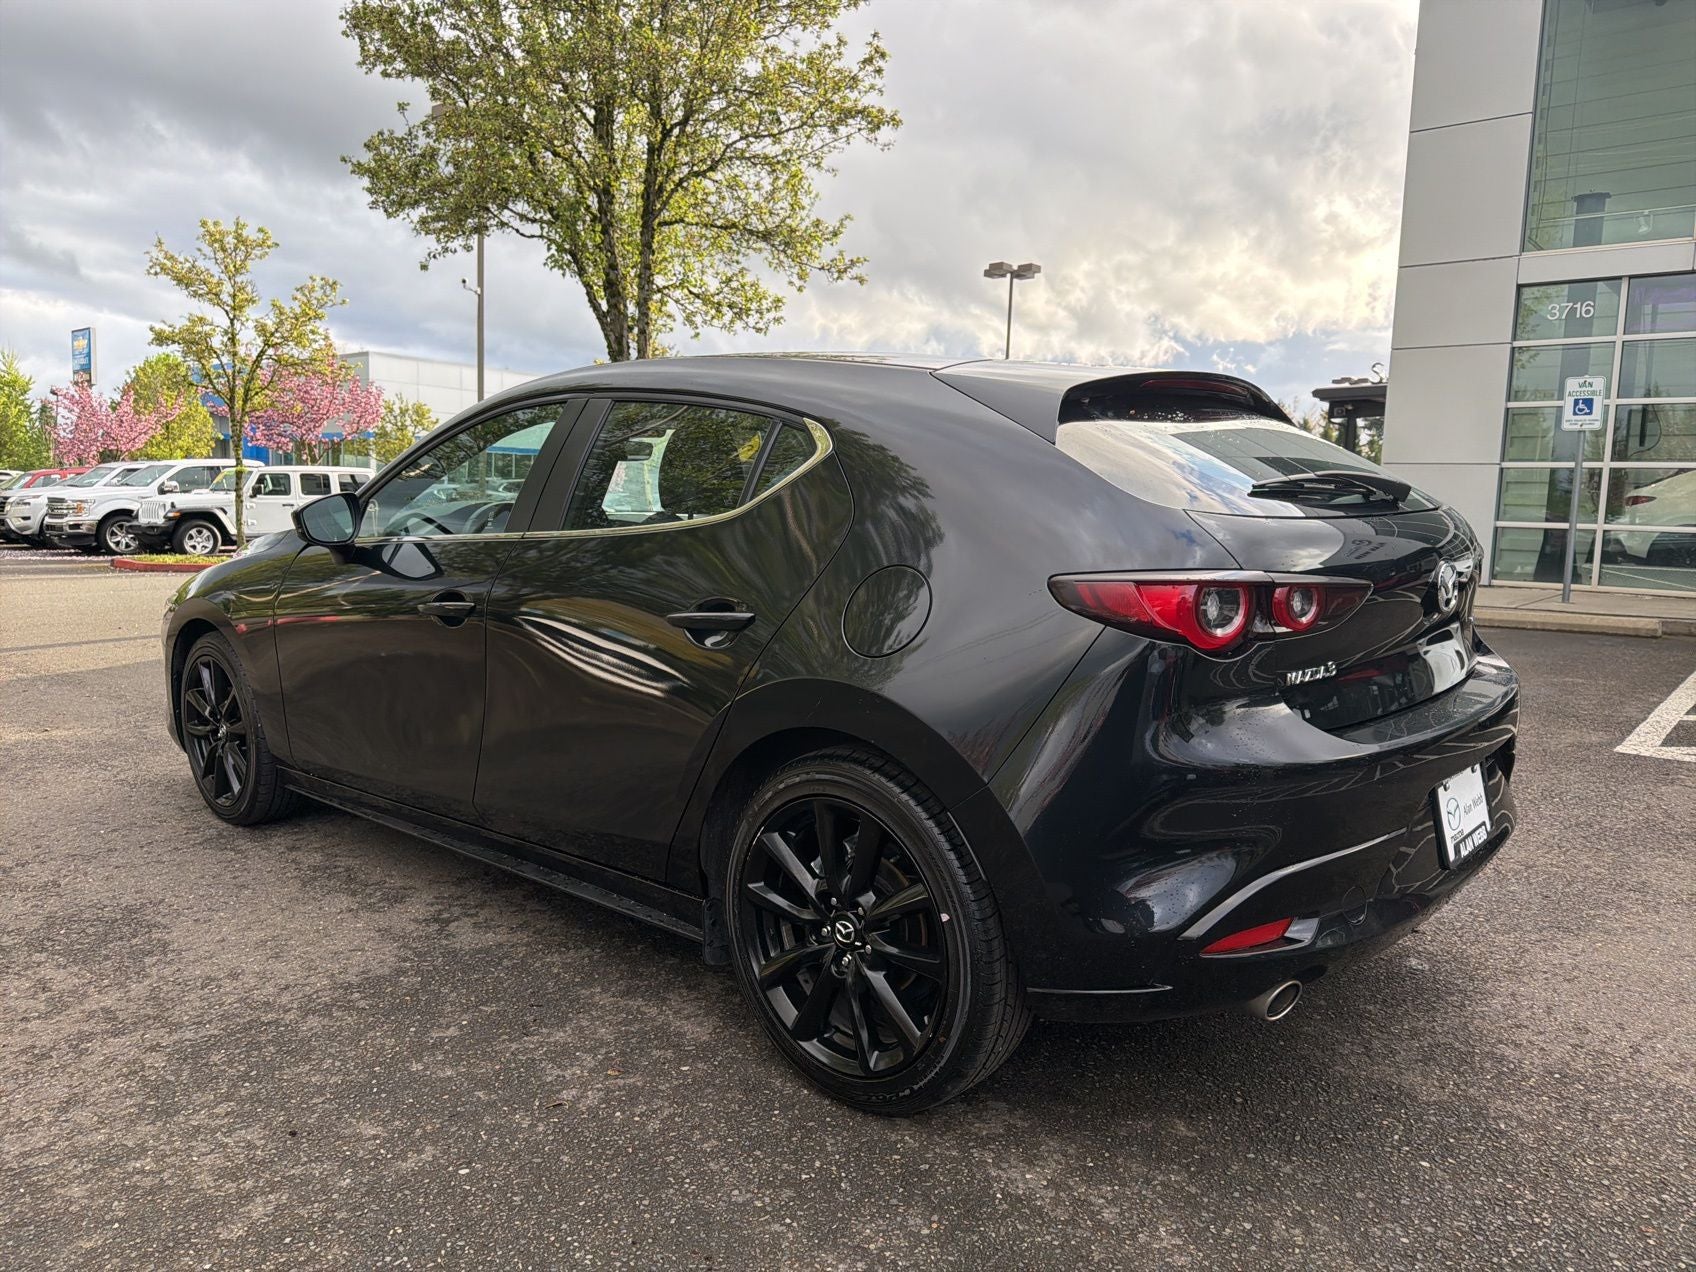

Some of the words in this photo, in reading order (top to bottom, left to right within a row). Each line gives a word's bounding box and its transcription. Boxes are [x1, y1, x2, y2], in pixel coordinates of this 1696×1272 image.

[1546, 300, 1595, 320] 3716
[1577, 380, 1594, 389] VAN
[1567, 389, 1602, 398] ACCESSIBLE
